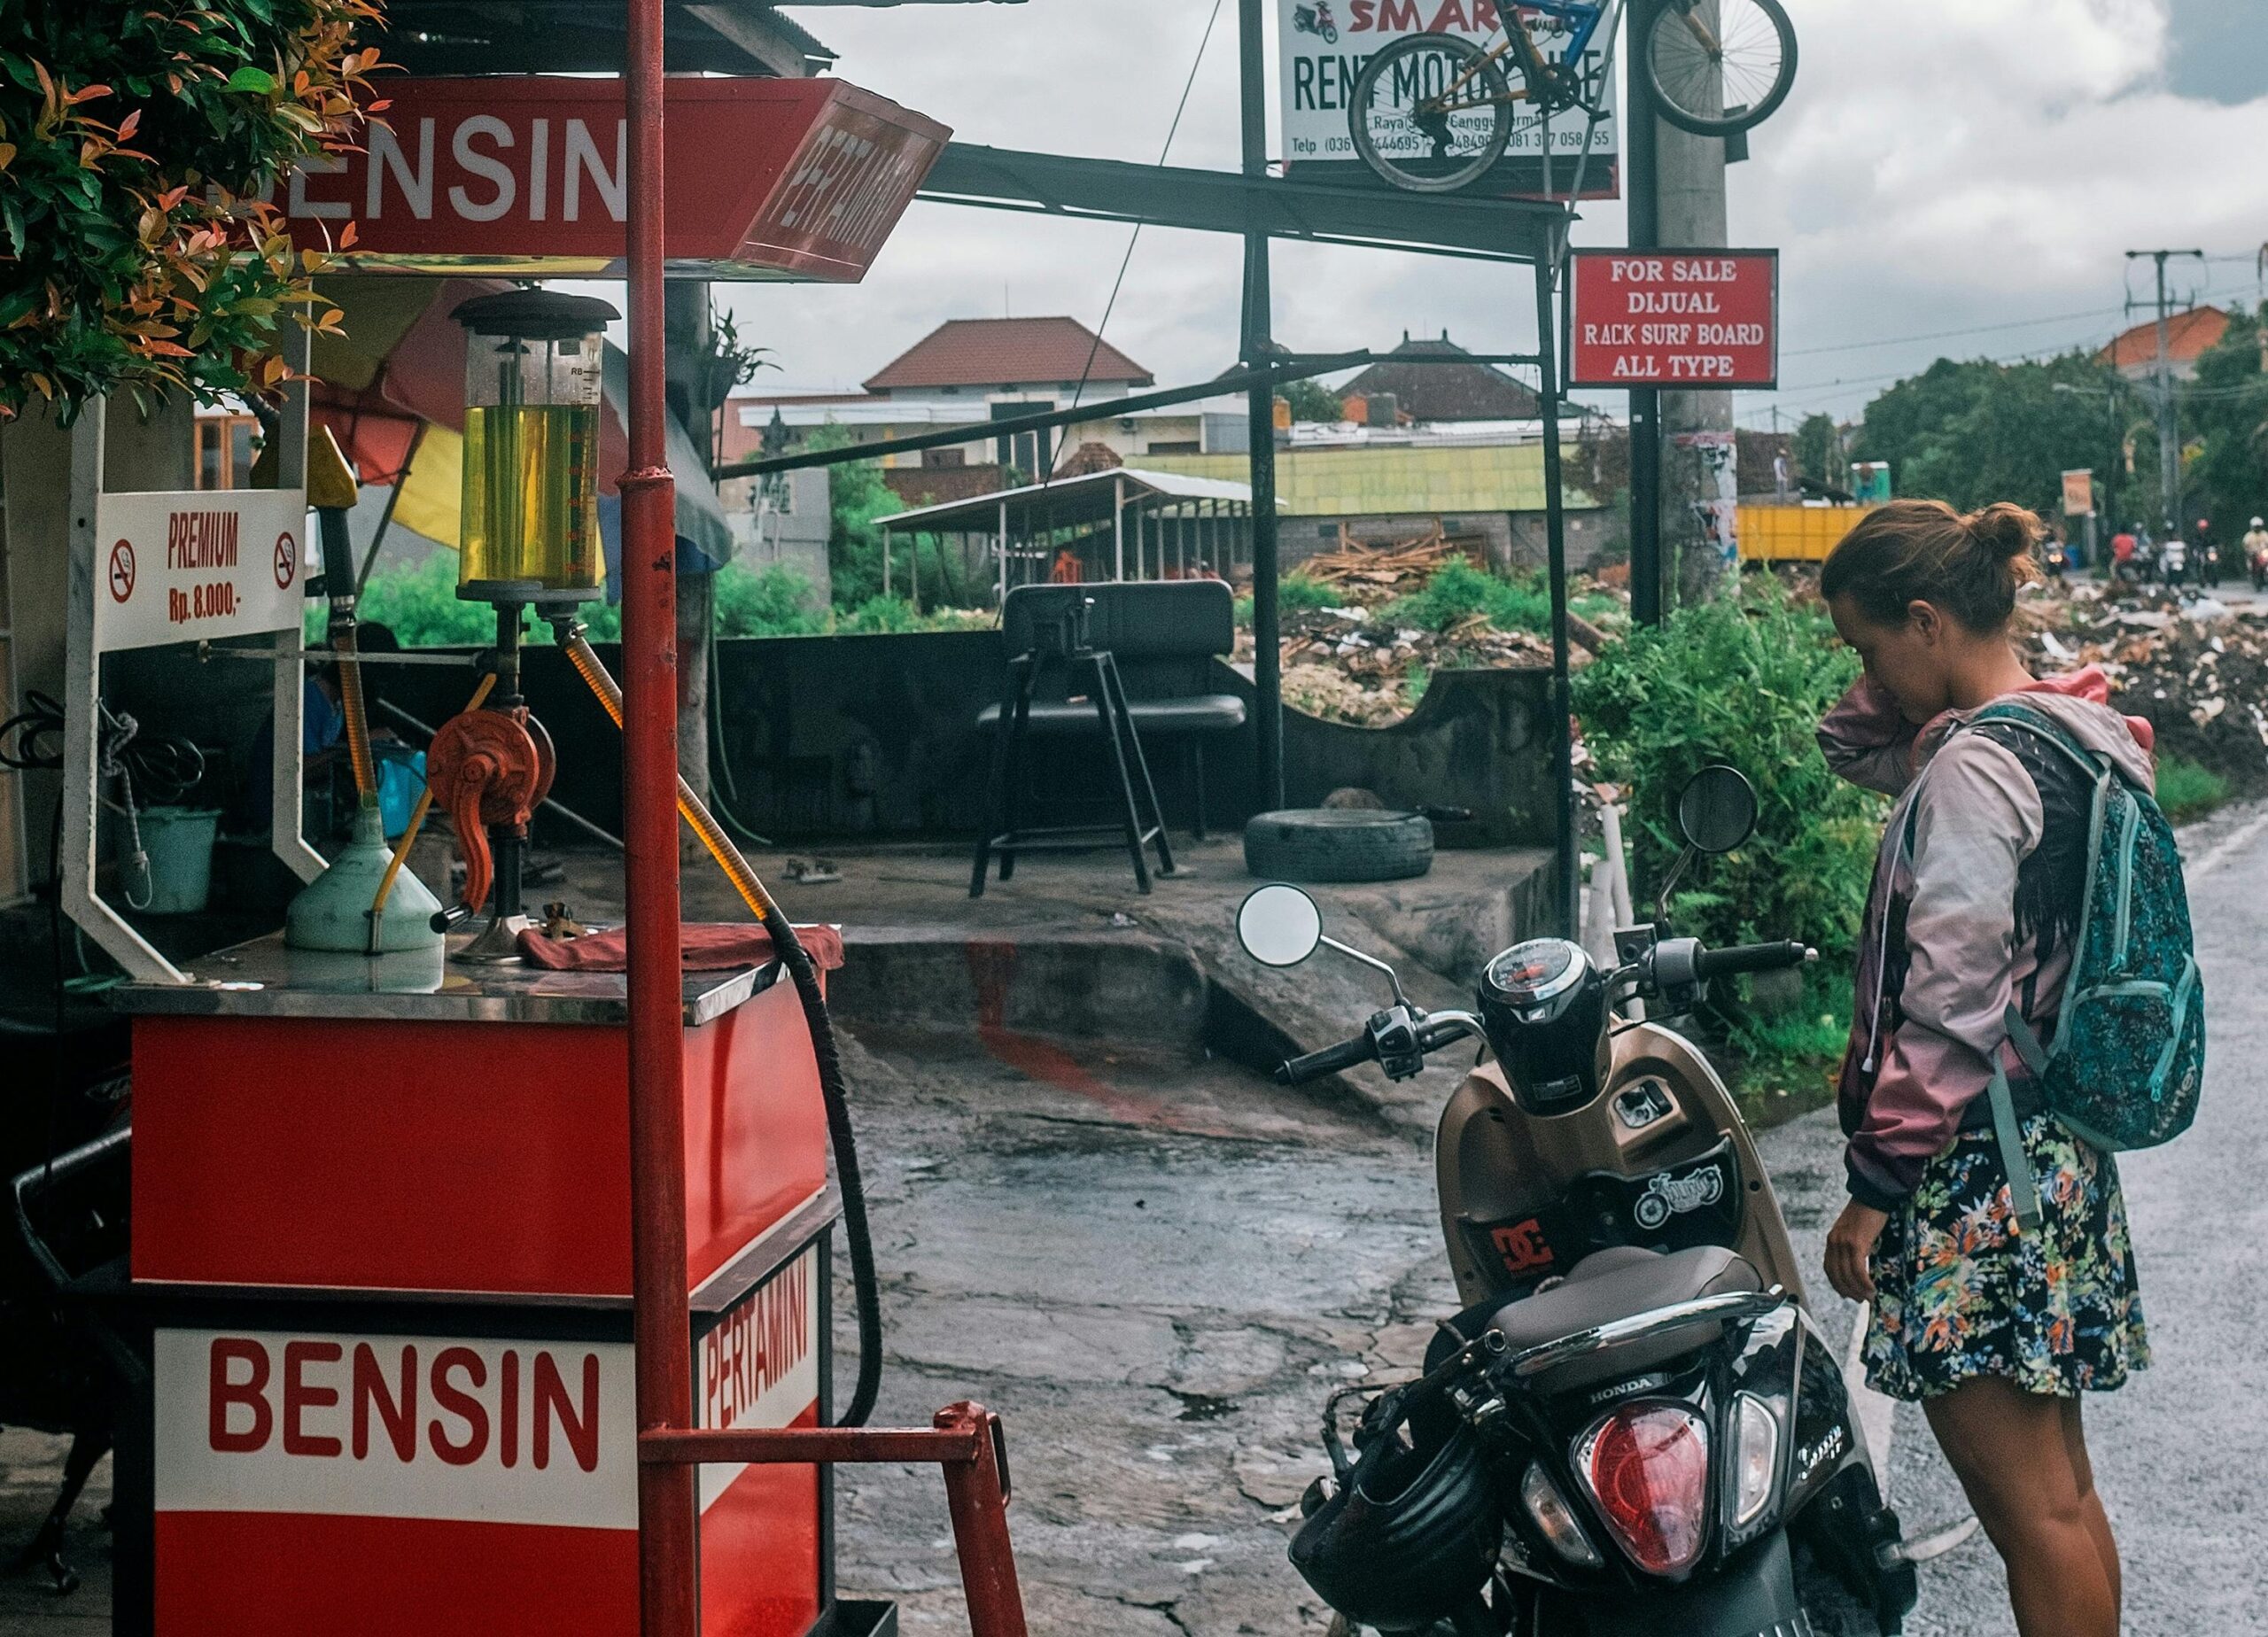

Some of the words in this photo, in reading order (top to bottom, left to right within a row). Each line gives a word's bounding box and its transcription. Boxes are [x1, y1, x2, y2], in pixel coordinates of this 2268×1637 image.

[1348, 0, 1540, 32] SMAR
[1374, 116, 1404, 132] Raya
[1292, 137, 1317, 155] Telp
[1534, 132, 1556, 146] 37
[1611, 260, 1665, 283] FOR
[1673, 260, 1737, 283] SALE
[1627, 292, 1720, 314] DIJUAL
[1584, 324, 1637, 345] RACK
[1641, 324, 1692, 345] SURF
[1697, 323, 1764, 345] BOARD
[1612, 355, 1660, 377] ALL
[1668, 355, 1735, 377] TYPE
[167, 511, 239, 570] PREMIUM
[168, 587, 191, 625] Rp.
[707, 1252, 807, 1429] PERTAMINI
[1590, 1378, 1653, 1404] HONDA
[209, 1337, 599, 1473] BENSIN
